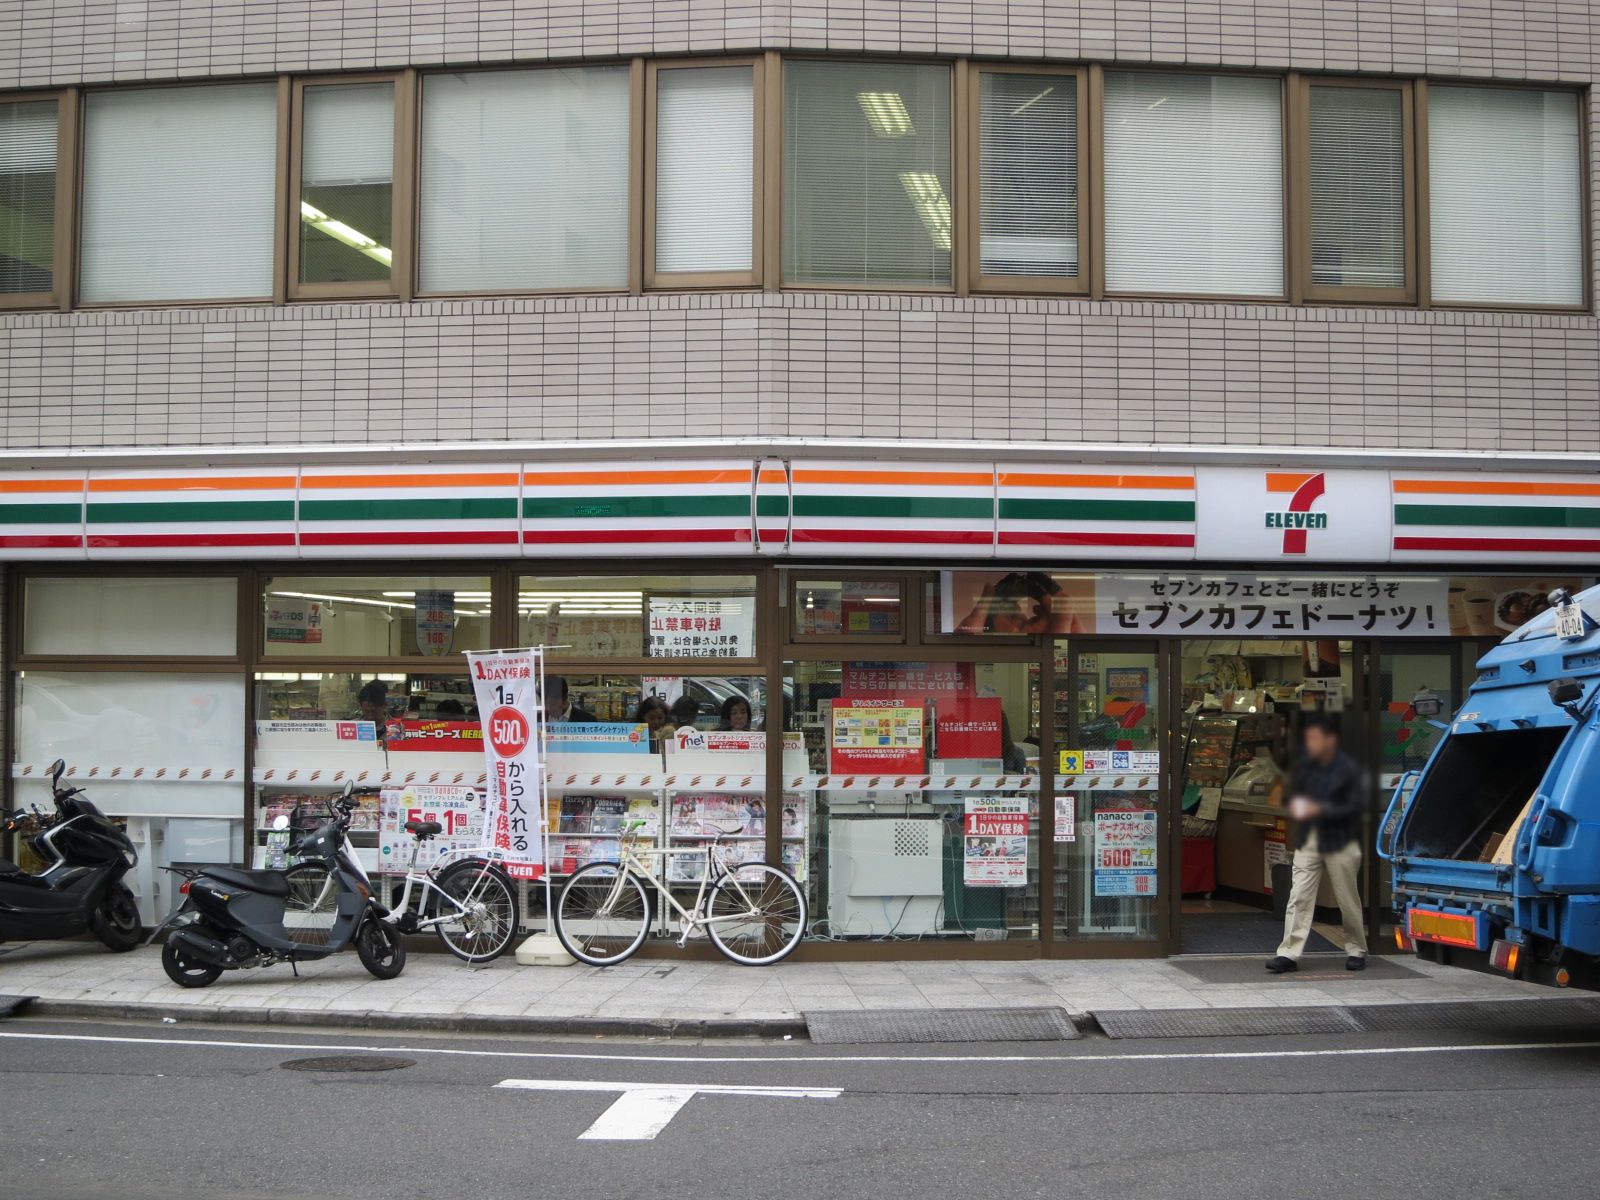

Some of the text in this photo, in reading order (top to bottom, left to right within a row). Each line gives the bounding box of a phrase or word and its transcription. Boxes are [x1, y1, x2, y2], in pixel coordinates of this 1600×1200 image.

[1265, 473, 1325, 554] 7
[1151, 581, 1400, 598] セブンカフェとご一緒にどうぞ
[1112, 601, 1435, 631] セブンカフェドーナツ!
[496, 685, 514, 704] 1日
[494, 719, 526, 745] 500円
[509, 761, 528, 852] から入れる
[968, 815, 1024, 835] 1DAY保険
[1103, 848, 1131, 867] 500
